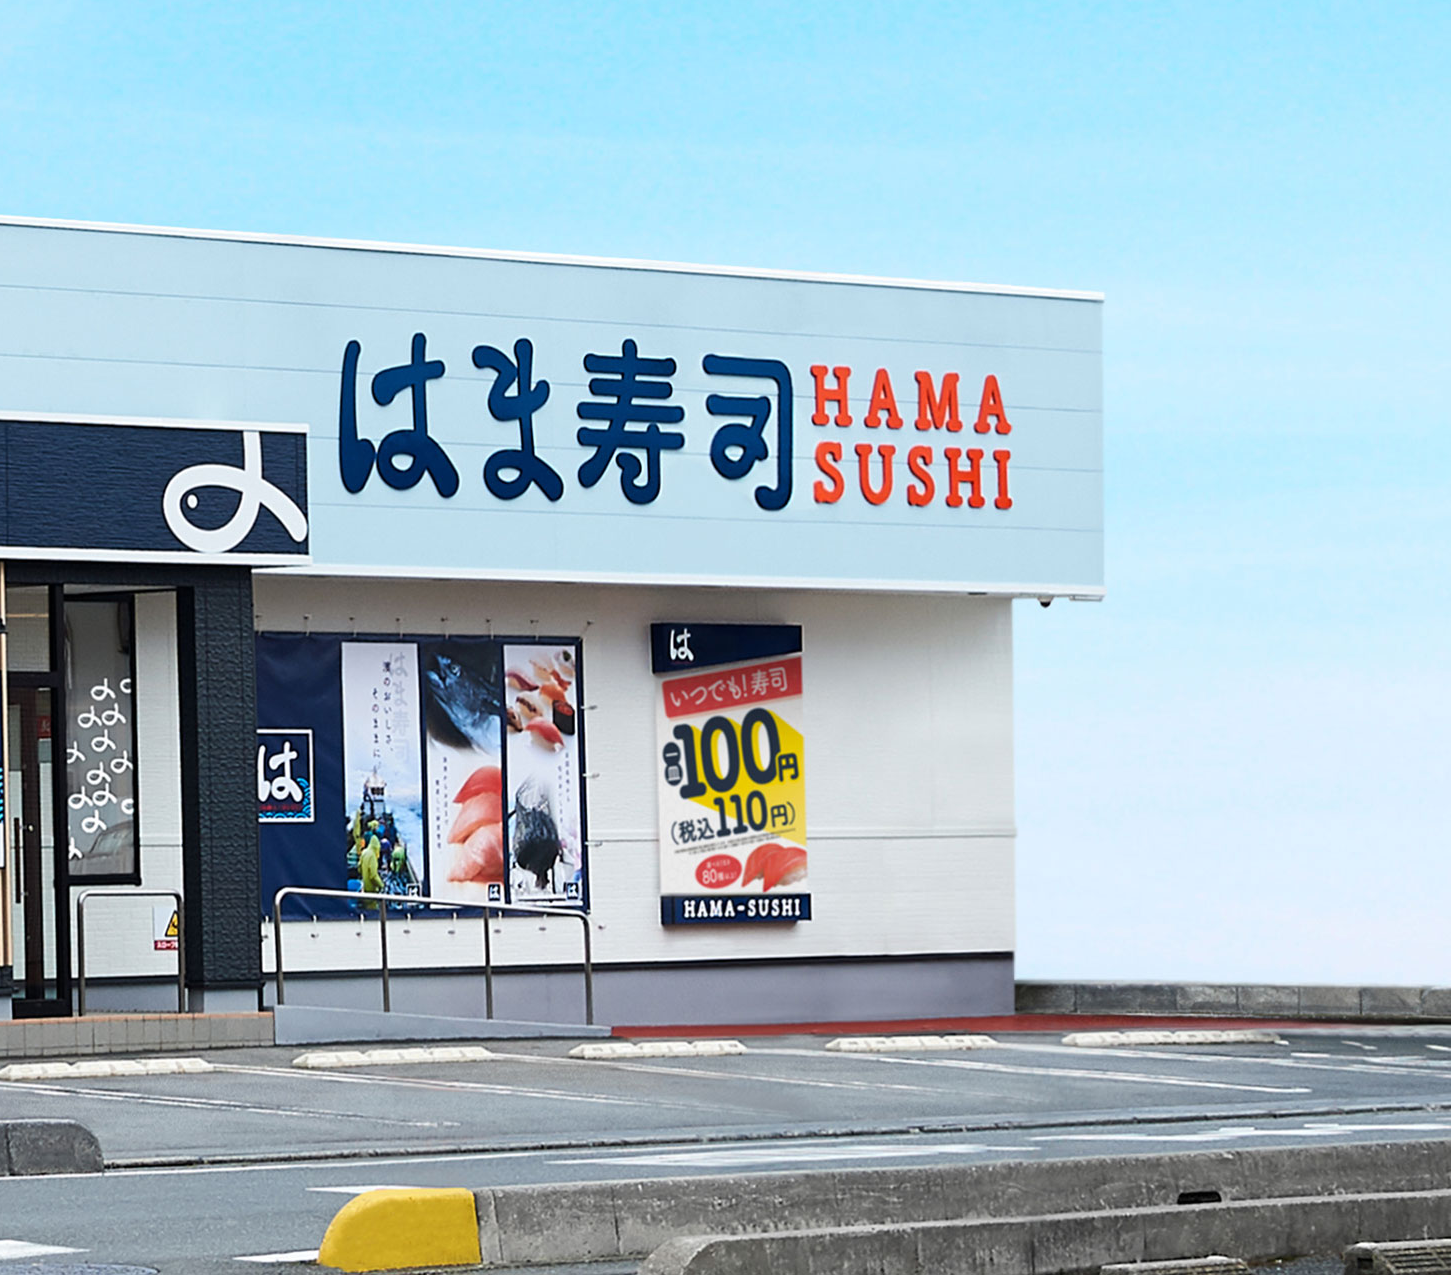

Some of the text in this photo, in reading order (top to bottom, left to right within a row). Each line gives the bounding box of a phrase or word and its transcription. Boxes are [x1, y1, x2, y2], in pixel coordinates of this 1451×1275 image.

[338, 332, 794, 511] はま寿司
[810, 364, 1013, 435] HAMA
[813, 441, 1013, 509] SUSHI
[670, 628, 694, 661] は
[670, 667, 788, 707] いつでも！寿司
[258, 741, 303, 802] は
[673, 708, 799, 800] 100円
[684, 898, 801, 918] HAMA-SUSHI
